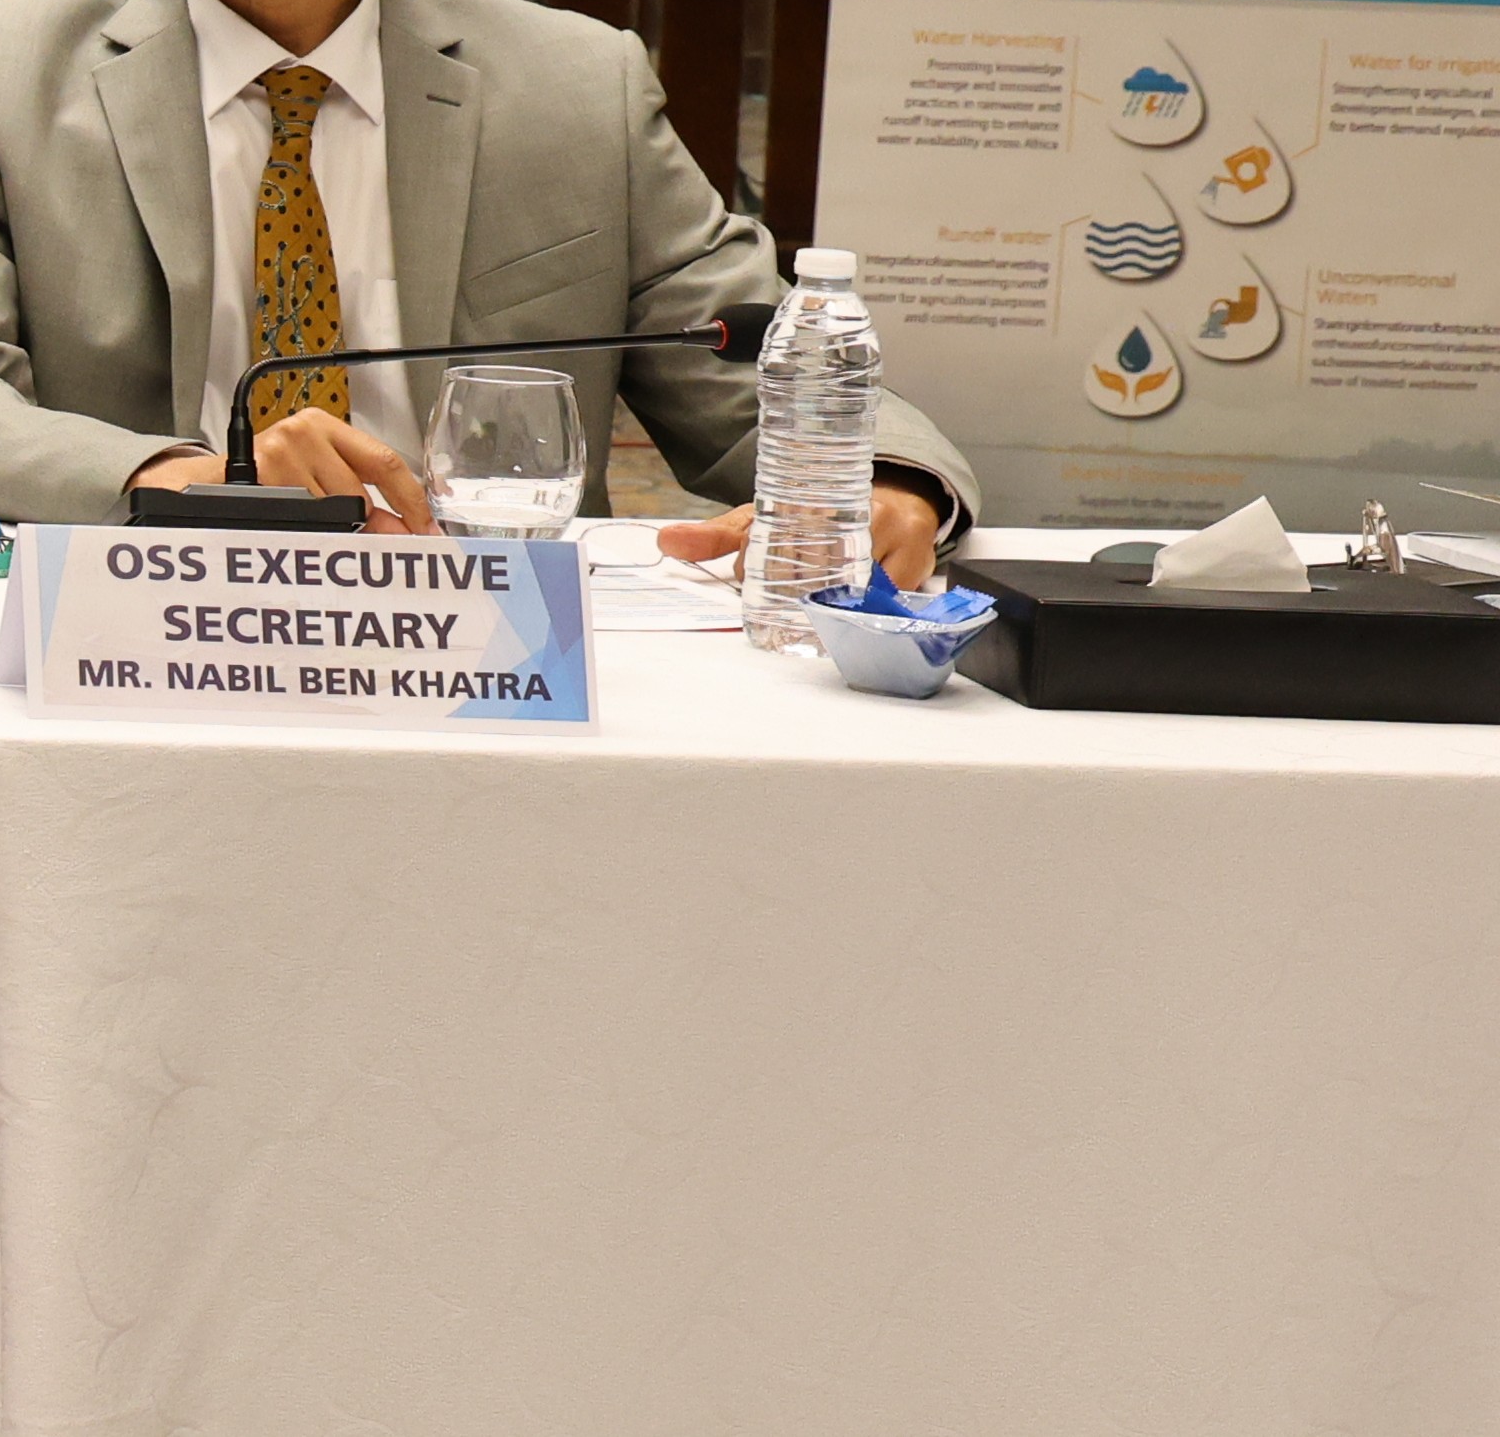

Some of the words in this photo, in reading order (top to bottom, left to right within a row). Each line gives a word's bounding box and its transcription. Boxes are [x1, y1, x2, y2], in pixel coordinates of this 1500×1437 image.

[107, 544, 206, 582] OSS
[226, 548, 510, 591] EXECUTIVE
[164, 605, 458, 649] SECRETARY
[79, 659, 151, 688] MR.
[167, 662, 286, 693] NABIL
[300, 667, 376, 695] BEN
[392, 670, 553, 701] KHATRA
